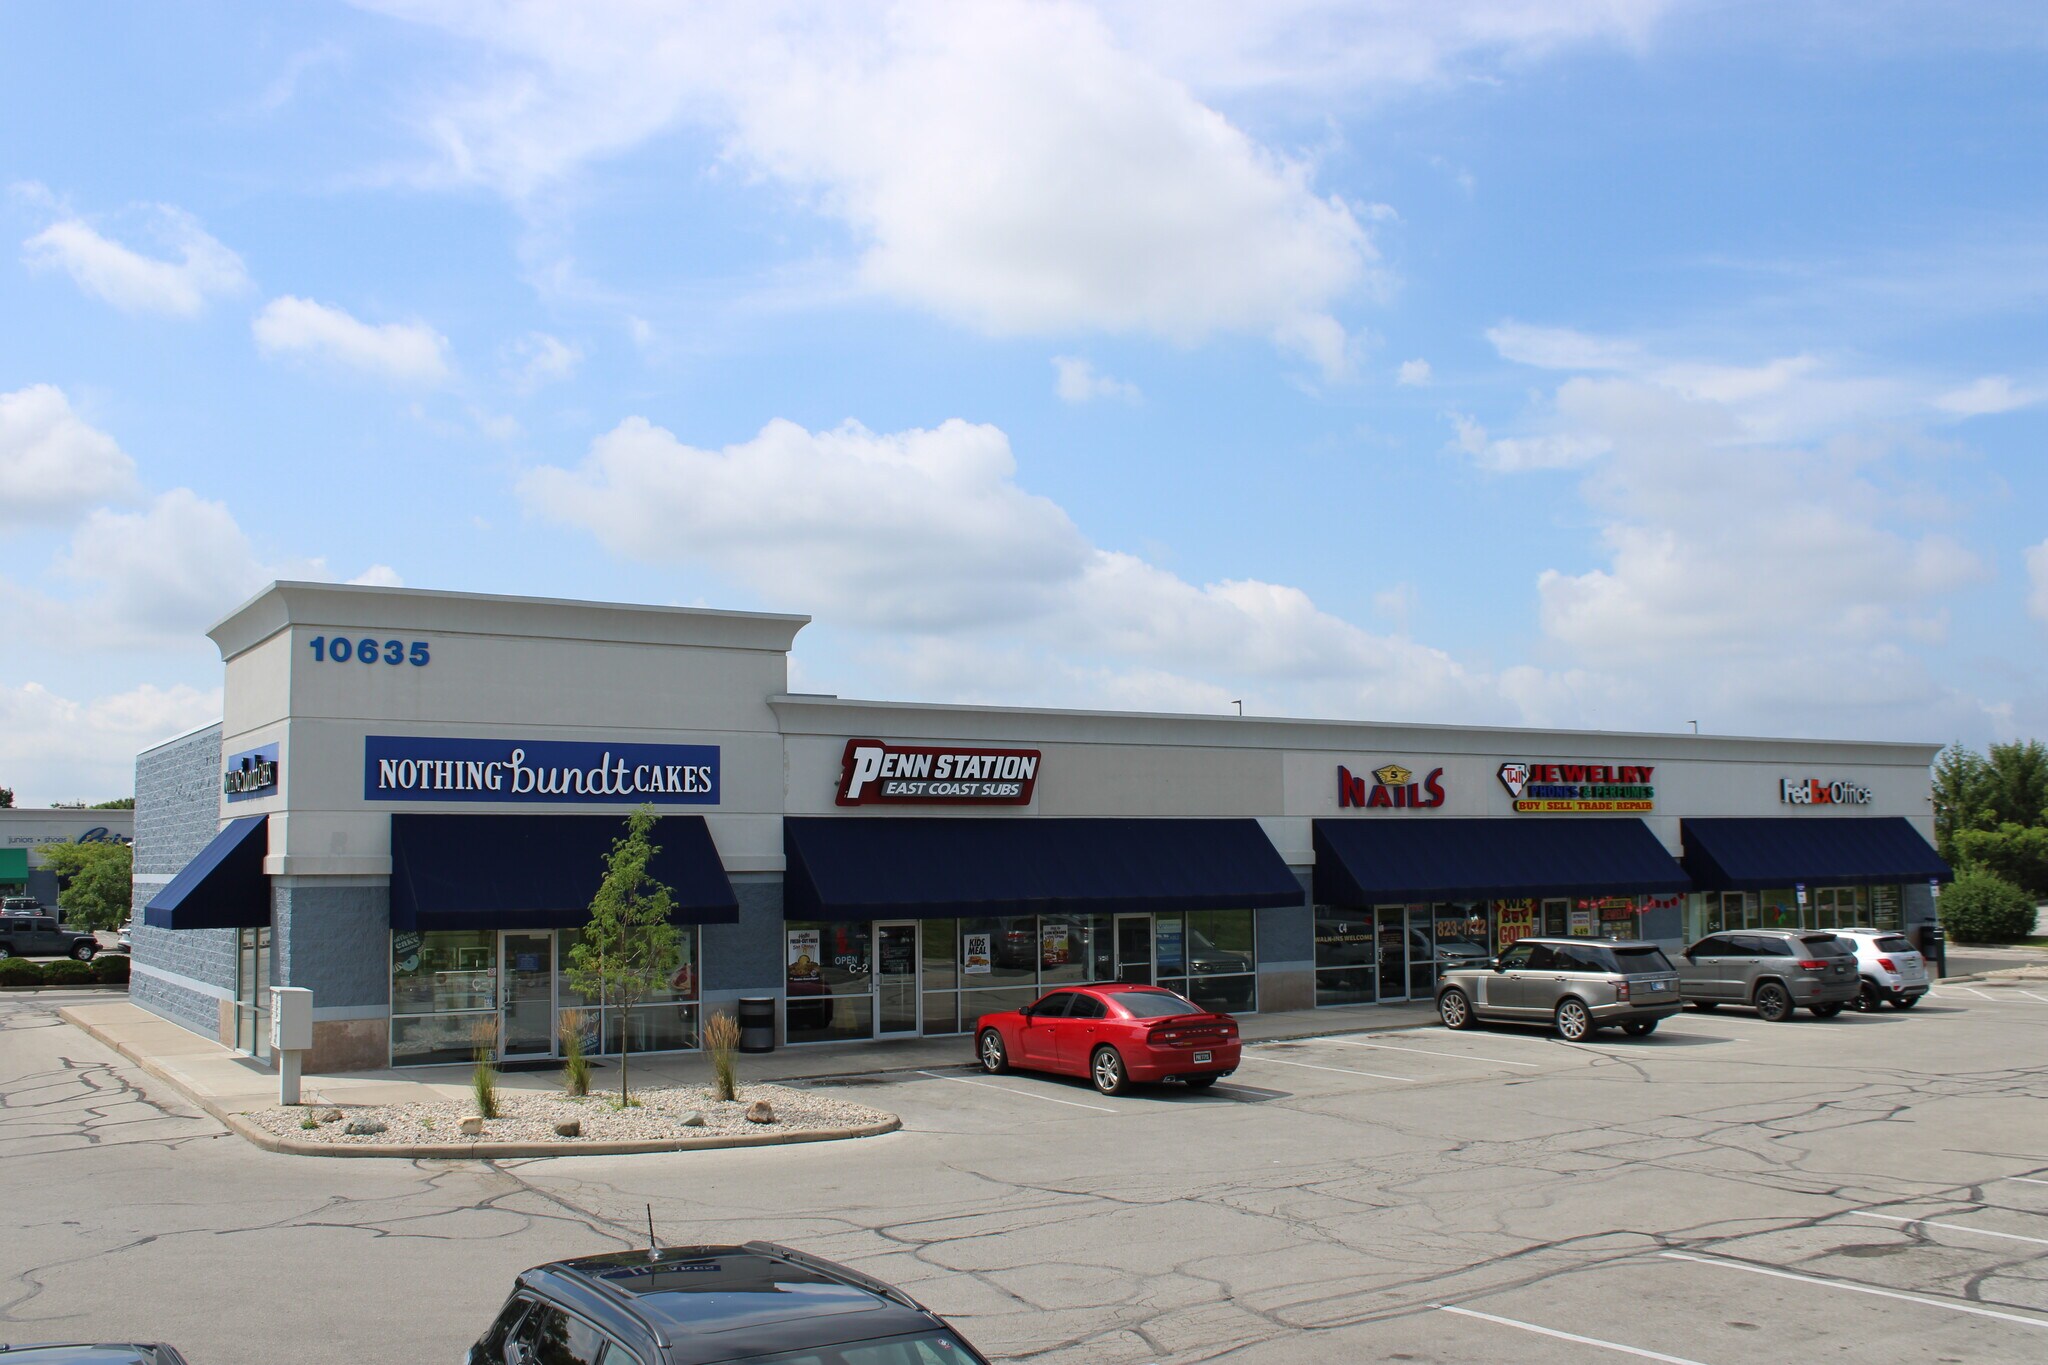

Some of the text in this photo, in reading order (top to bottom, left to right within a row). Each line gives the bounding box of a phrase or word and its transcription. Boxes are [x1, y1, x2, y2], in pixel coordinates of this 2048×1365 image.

[310, 636, 431, 667] 10635
[378, 748, 712, 796] NOTHING bundt CAKES
[846, 746, 1037, 799] PENN STATION
[1390, 770, 1398, 778] 5
[1529, 764, 1655, 783] JEWELRY
[886, 782, 1020, 796] EAST COAST SUBS
[1337, 765, 1445, 808] NAILS
[1528, 785, 1655, 798] PHONES & PERFUMES
[1780, 779, 1873, 804] FedEx Office
[1518, 801, 1653, 810] BUY SELL TRADE REPAIR
[8, 835, 67, 844] juniors shoes
[1343, 934, 1373, 942] WELCOME
[1499, 925, 1532, 944] GOLD
[969, 938, 985, 947] KIDS
[967, 946, 987, 955] MEAL
[834, 954, 858, 965] OPEN
[848, 963, 869, 974] C-2
